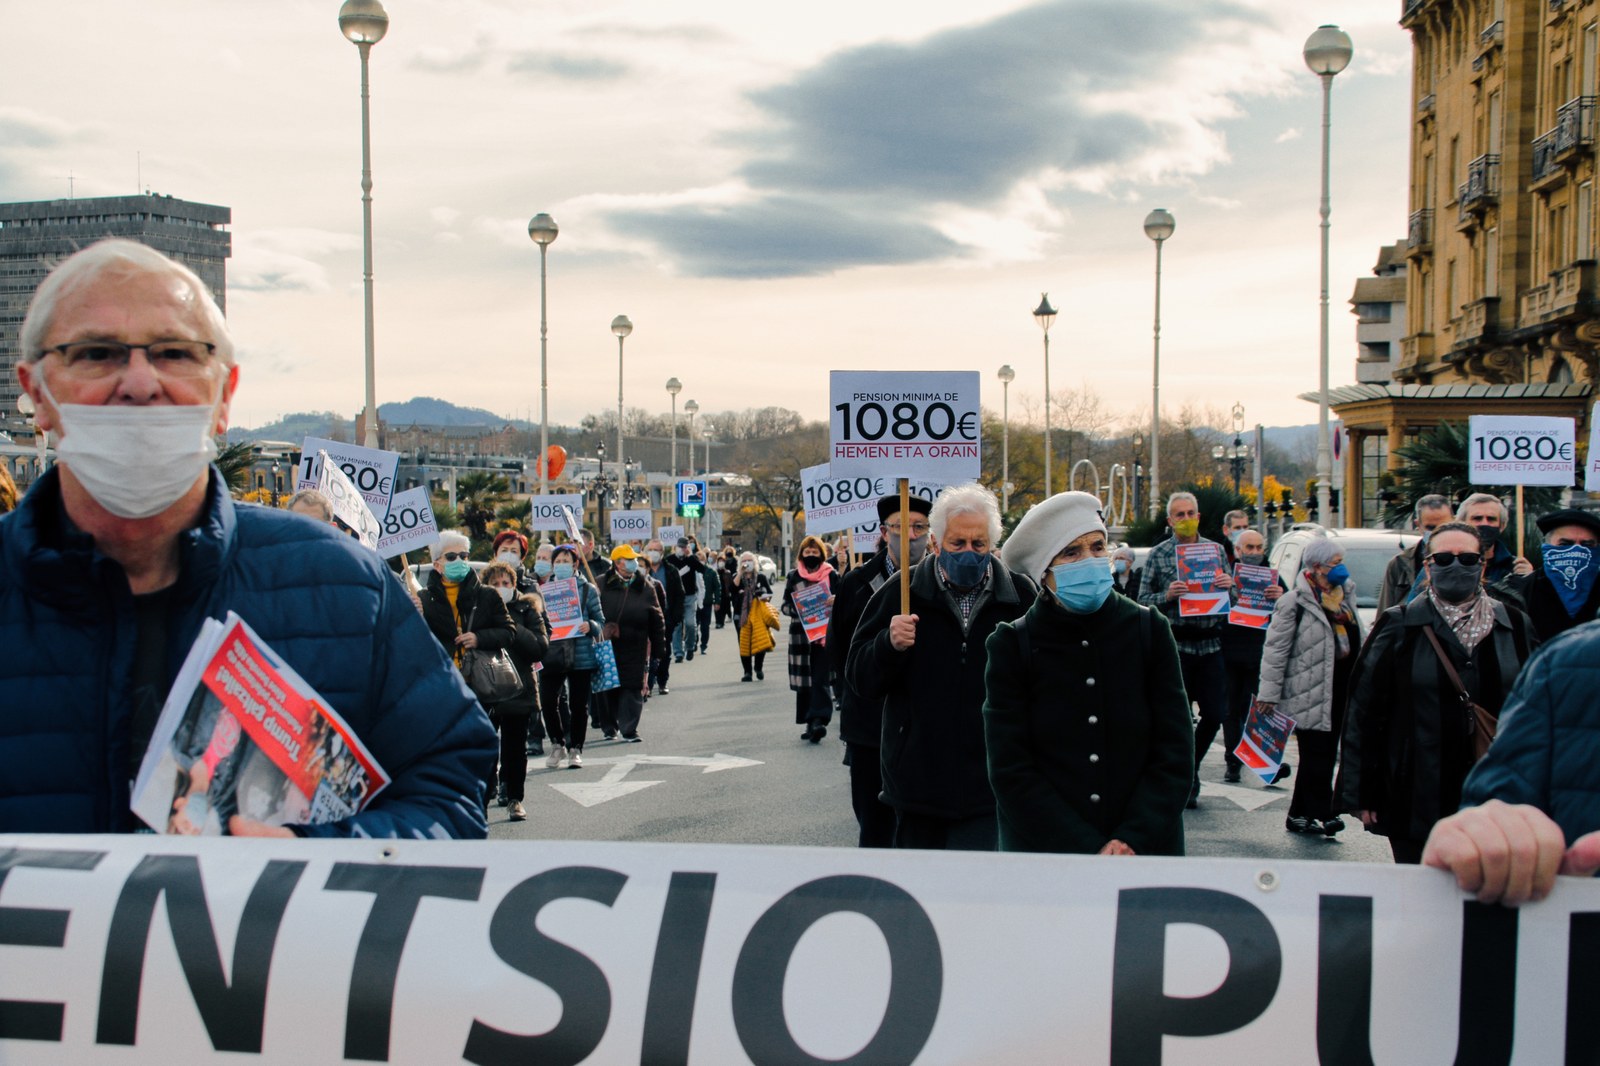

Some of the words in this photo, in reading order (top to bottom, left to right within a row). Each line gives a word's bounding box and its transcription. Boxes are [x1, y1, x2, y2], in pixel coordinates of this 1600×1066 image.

[853, 393, 900, 402] PENSION
[902, 393, 942, 402] MINIMA
[944, 393, 959, 401] DE
[835, 402, 977, 441] 1080€
[835, 446, 889, 458] HEMEN
[893, 446, 924, 458] ETA
[928, 446, 977, 458] ORAIN
[1475, 436, 1572, 461] 1080€
[347, 458, 373, 468] MINIMA
[1474, 463, 1512, 472] HEMEN
[1514, 463, 1535, 472] ETA
[1538, 463, 1573, 472] ORAIN
[303, 456, 391, 496] 180€
[682, 483, 698, 503] P
[806, 477, 885, 509] 1080€
[807, 508, 837, 520] HEMEN
[839, 504, 856, 515] ETA
[613, 518, 650, 529] 1080€
[390, 535, 406, 545] ETA
[407, 526, 435, 538] ORAIN
[215, 665, 268, 724] galtzaile!
[263, 714, 301, 763] Trump
[0, 849, 944, 1066] ENTSIO
[1110, 886, 1600, 1066] PU
